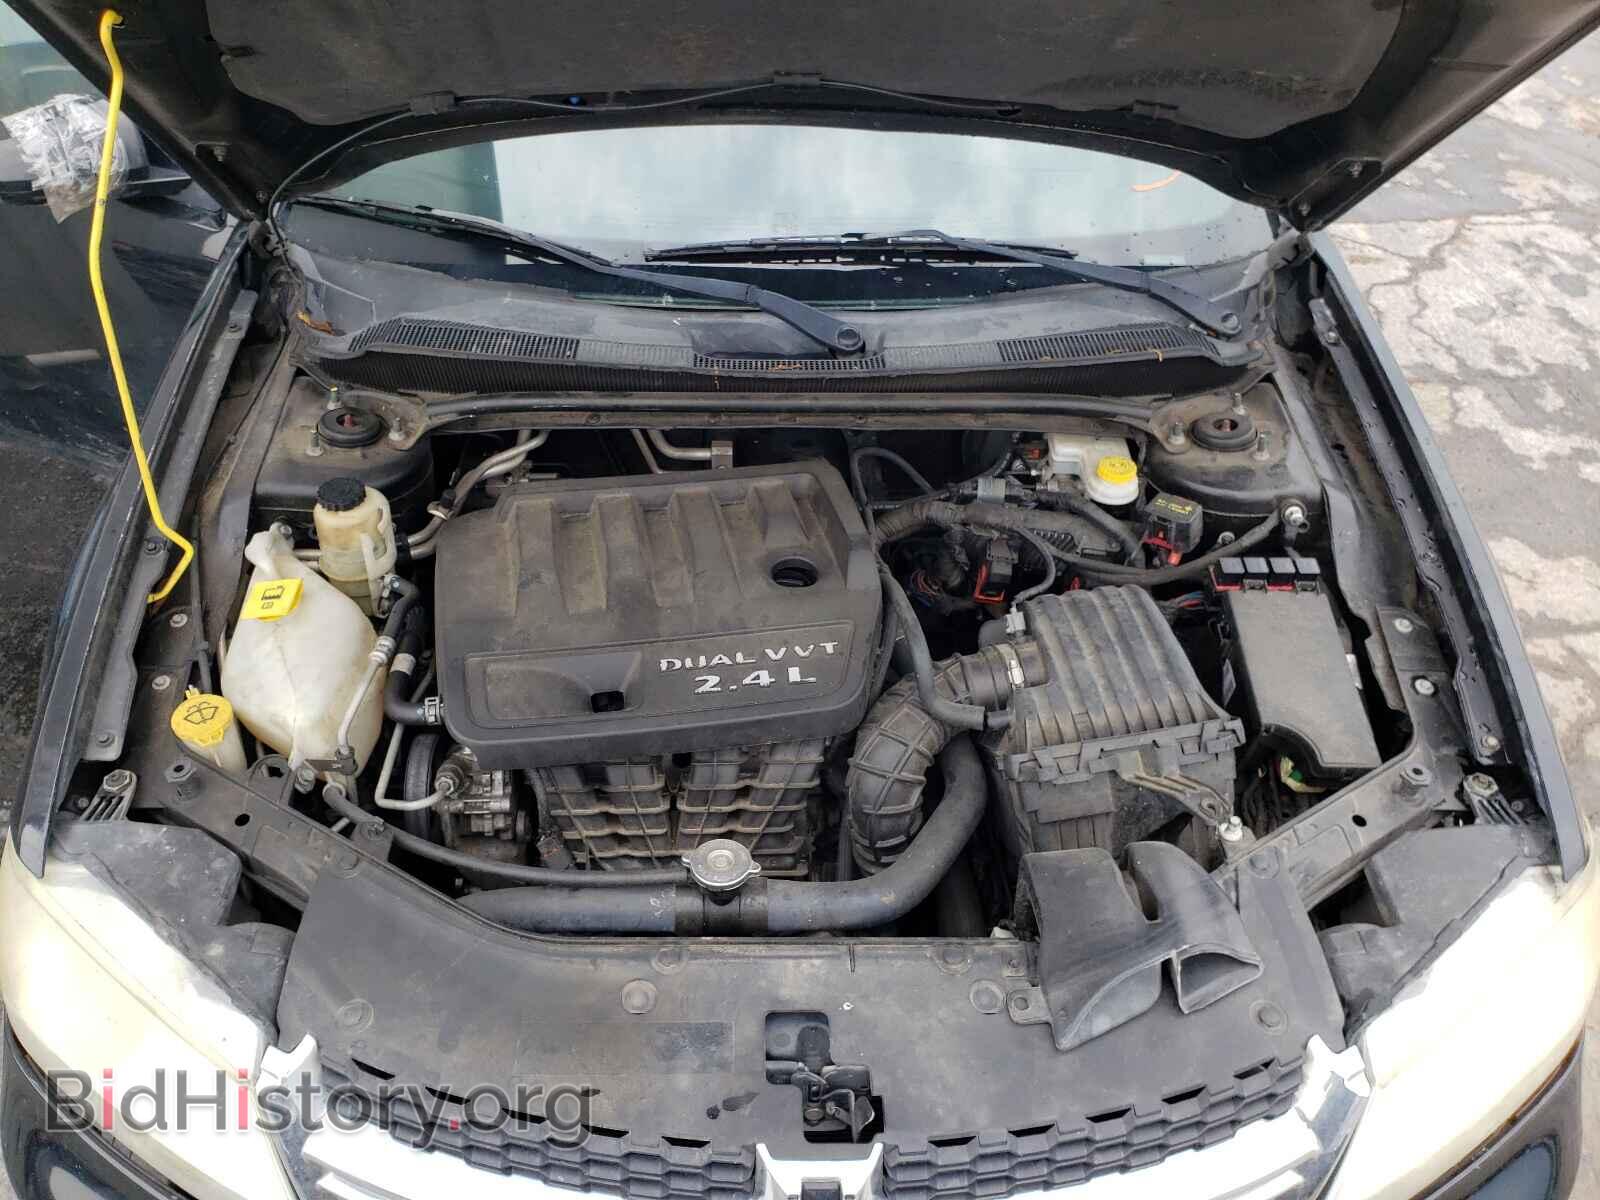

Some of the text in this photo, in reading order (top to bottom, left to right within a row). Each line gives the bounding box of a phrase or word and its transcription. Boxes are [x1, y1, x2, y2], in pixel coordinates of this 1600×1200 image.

[660, 642, 838, 671] DUAL VVT
[694, 666, 816, 694] 2.4L
